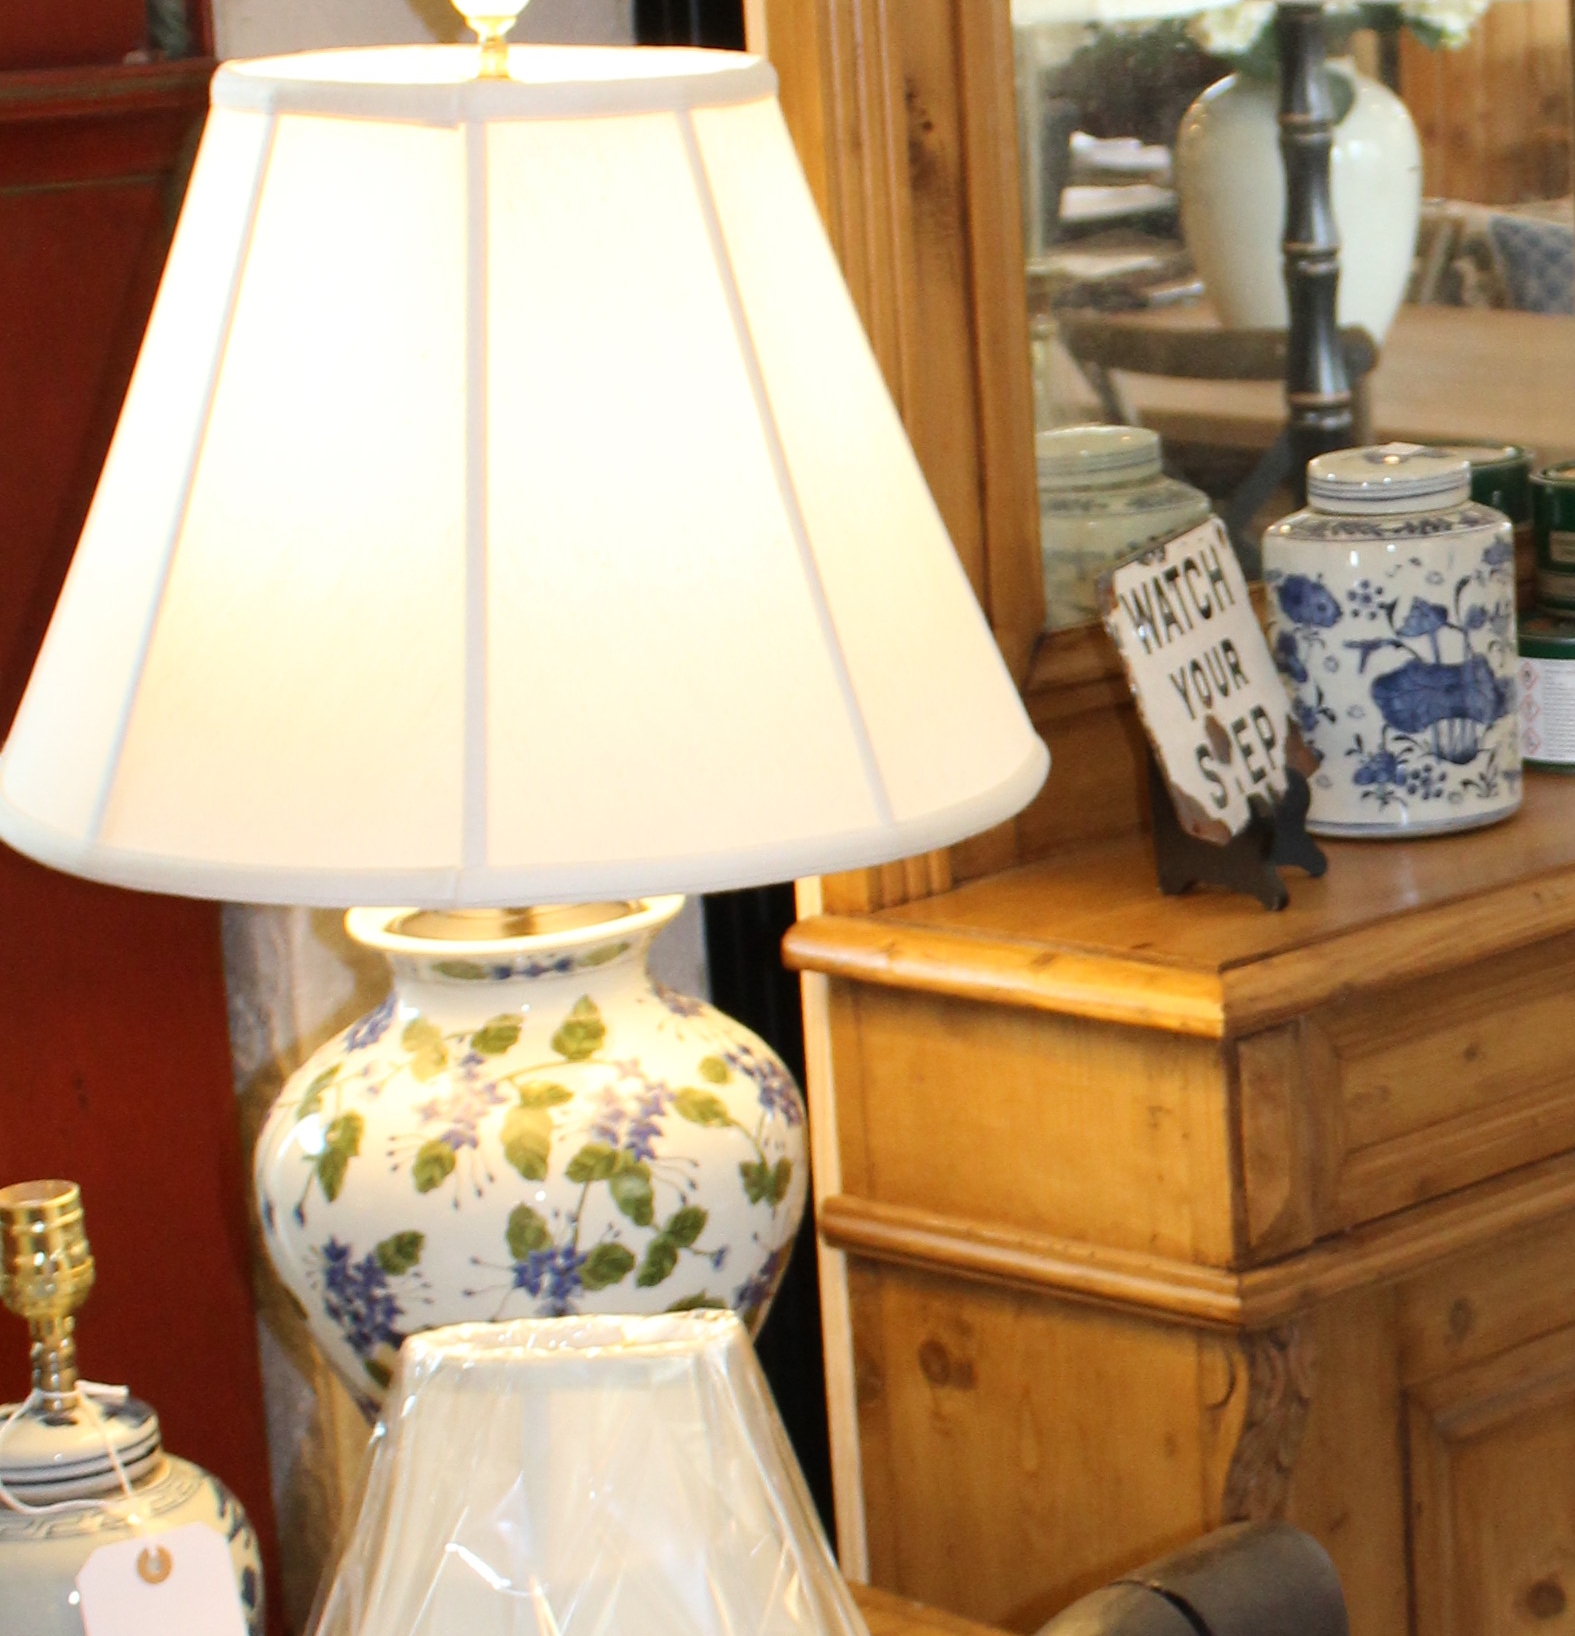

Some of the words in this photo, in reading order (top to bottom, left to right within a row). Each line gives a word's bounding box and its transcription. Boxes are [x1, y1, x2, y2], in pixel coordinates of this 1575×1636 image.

[1118, 544, 1235, 655] WATCH
[1169, 638, 1249, 721] YOUR
[1196, 704, 1276, 810] SEP
